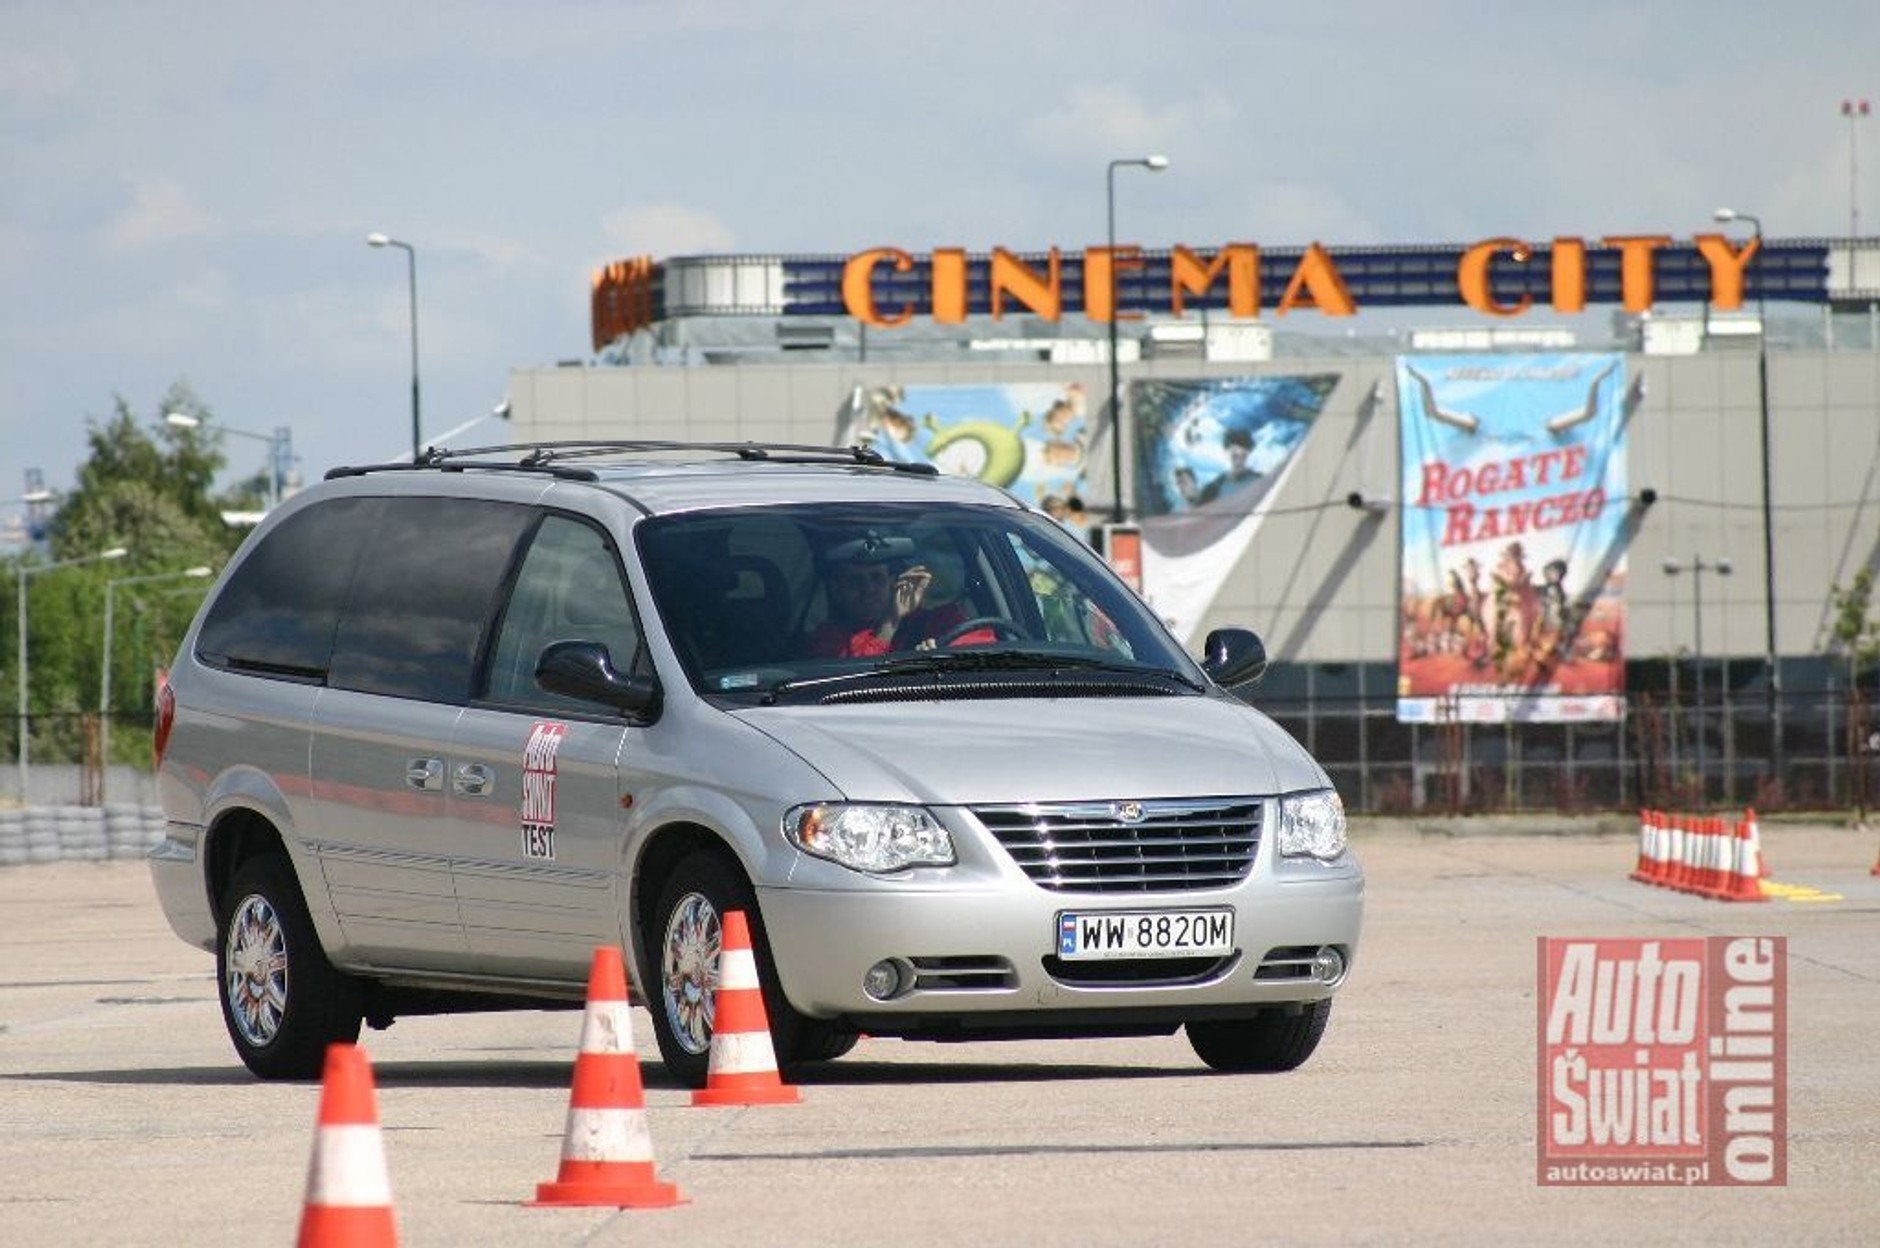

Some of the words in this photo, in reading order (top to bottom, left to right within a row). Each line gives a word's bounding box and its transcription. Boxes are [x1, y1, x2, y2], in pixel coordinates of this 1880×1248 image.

[842, 242, 1355, 327] CINEMA
[1457, 234, 1762, 316] CITY
[1416, 446, 1589, 508] ROGATE
[1441, 487, 1607, 547] RANCZO
[522, 824, 555, 857] TEST
[1083, 918, 1125, 949] WW
[1137, 915, 1227, 948] 8820M
